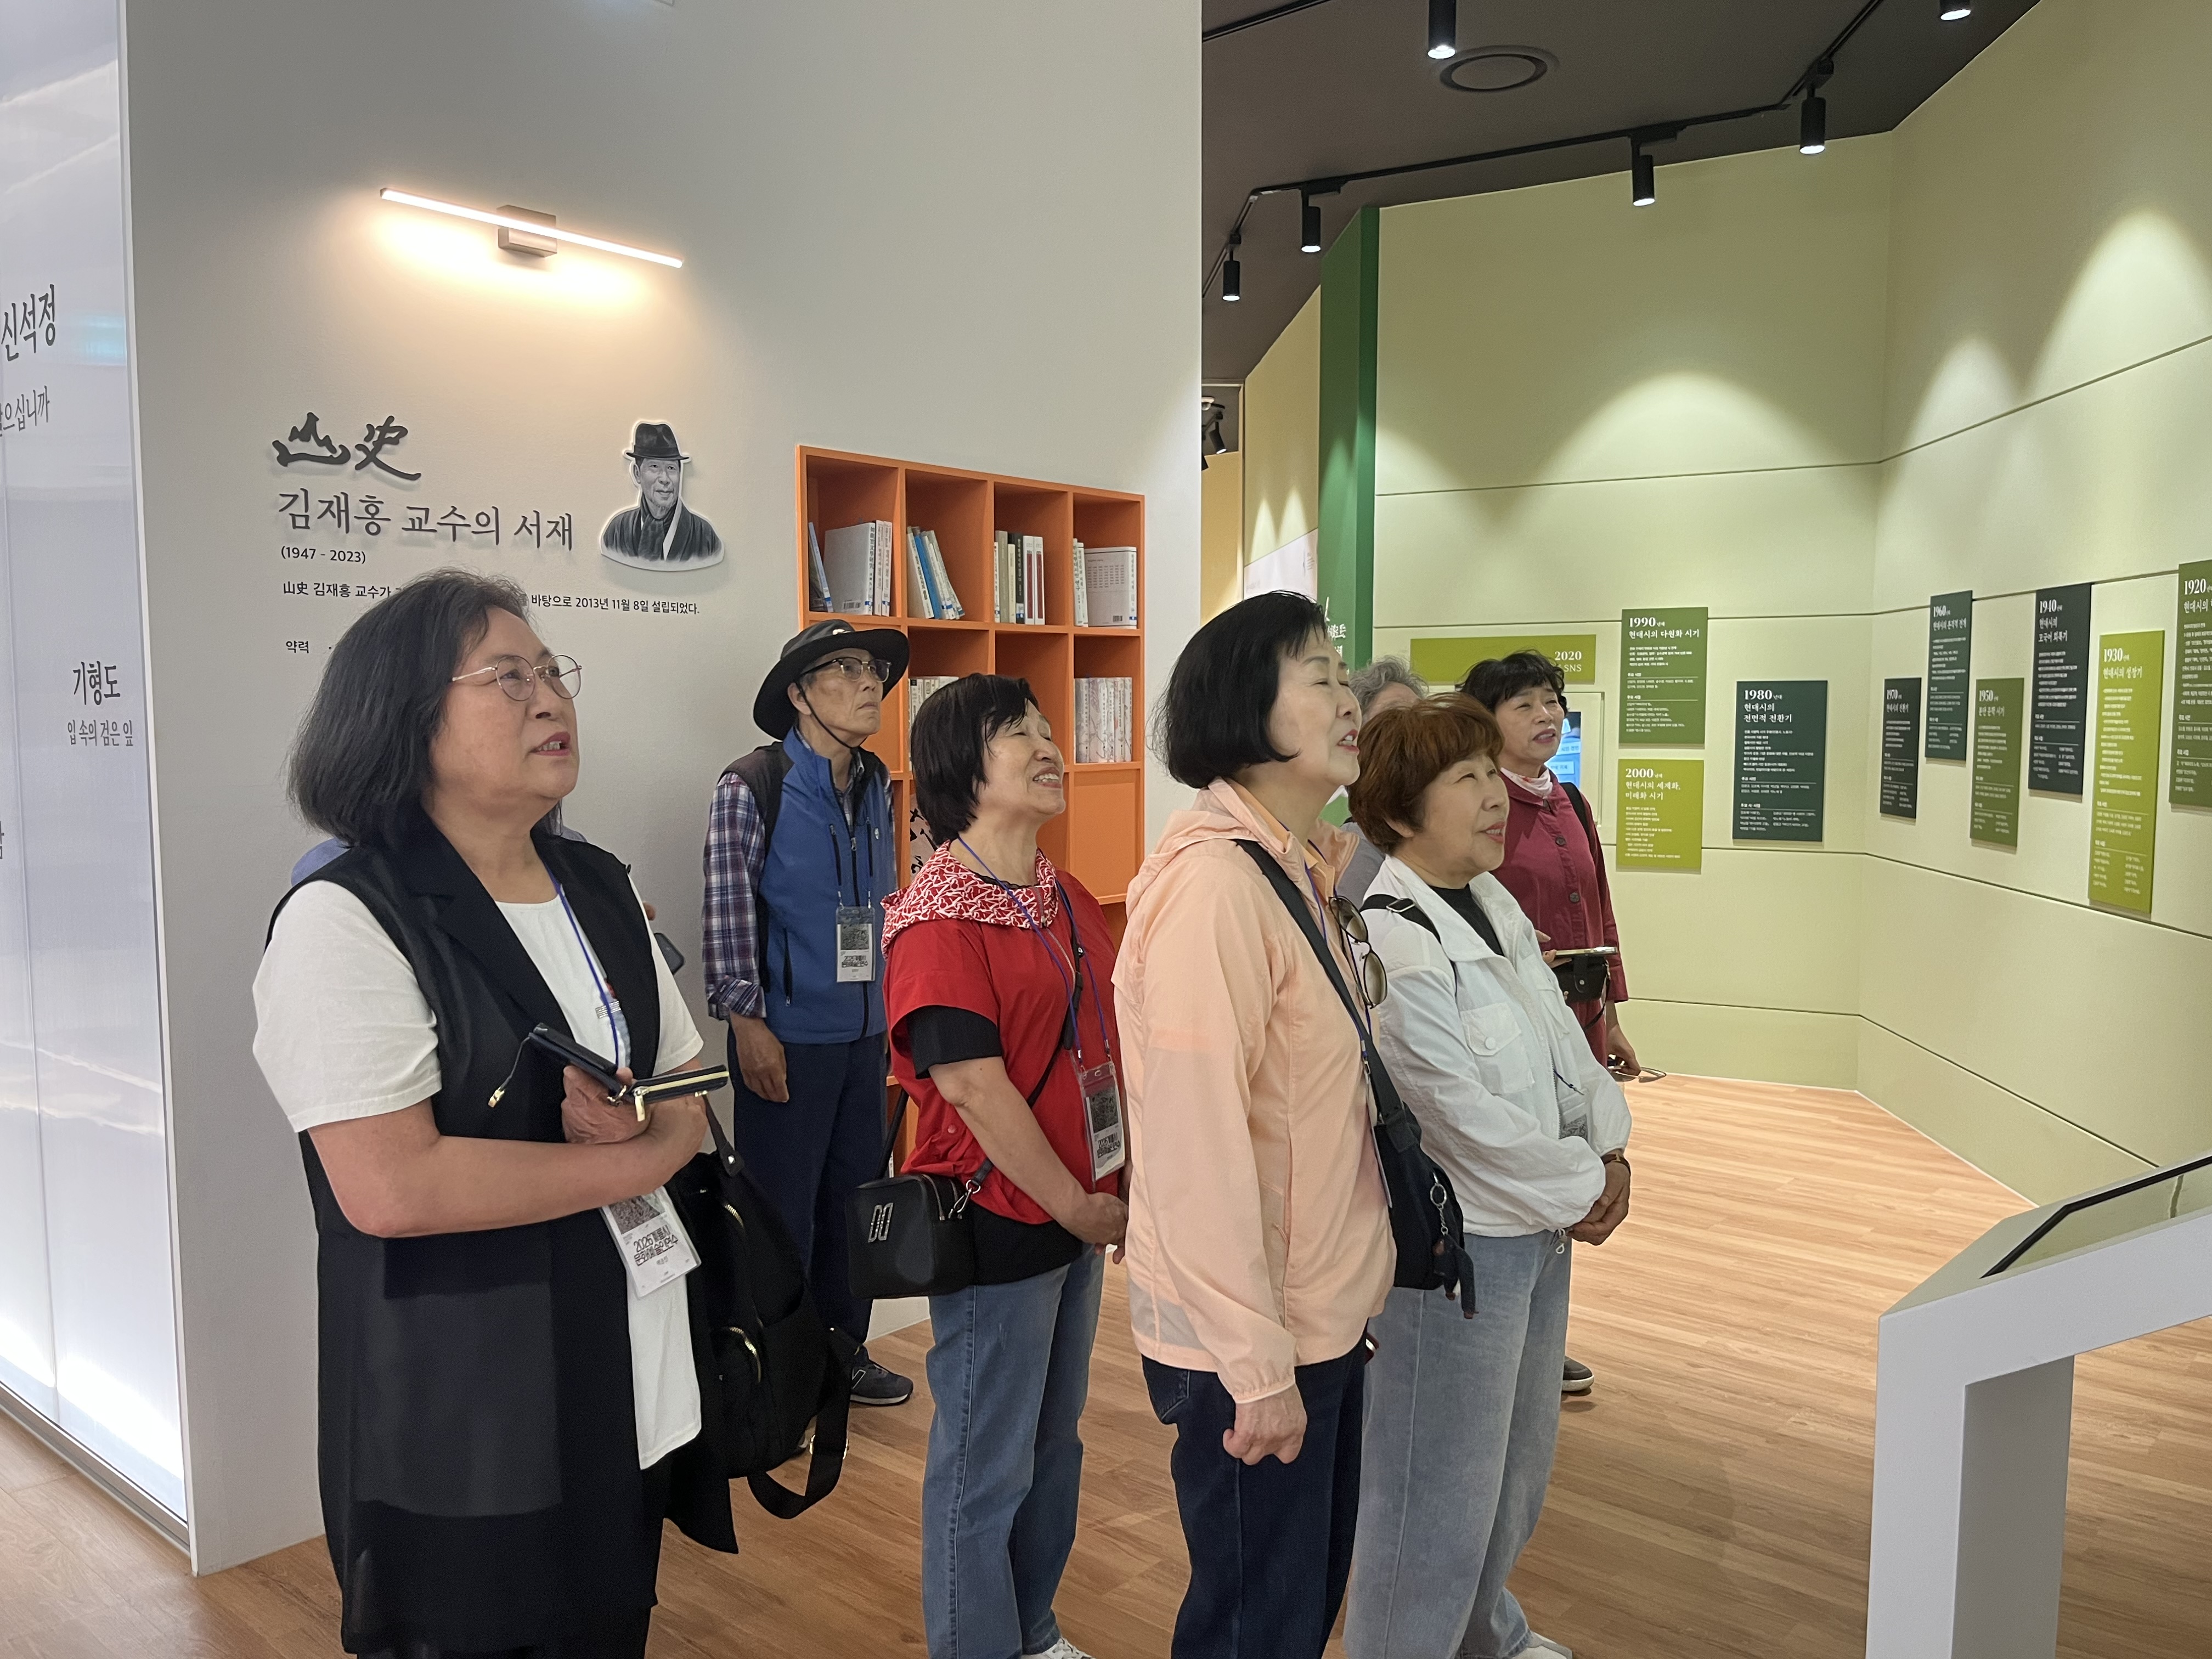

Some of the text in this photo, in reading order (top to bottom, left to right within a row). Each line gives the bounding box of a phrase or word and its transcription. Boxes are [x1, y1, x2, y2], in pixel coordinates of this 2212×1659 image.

[1, 284, 55, 362] 신석정
[279, 488, 572, 551] 김재홍 교수의 서재
[281, 546, 316, 560] (1947
[330, 550, 366, 564] 2023)
[283, 582, 391, 599] 山史 김재홍 교수가
[532, 595, 699, 614] 바탕으로 2013년 11월 8일 설립되었다.
[1629, 630, 1657, 639] 현대시의
[1685, 629, 1699, 637] 시기
[286, 641, 309, 653] 약력
[1555, 651, 1582, 661] 2020
[1564, 664, 1582, 672] SNS
[72, 661, 121, 705] 기형도
[1744, 703, 1774, 712] 현대시의
[67, 720, 133, 747] 입 속의 검은 잎
[1649, 792, 1663, 800] 시기
